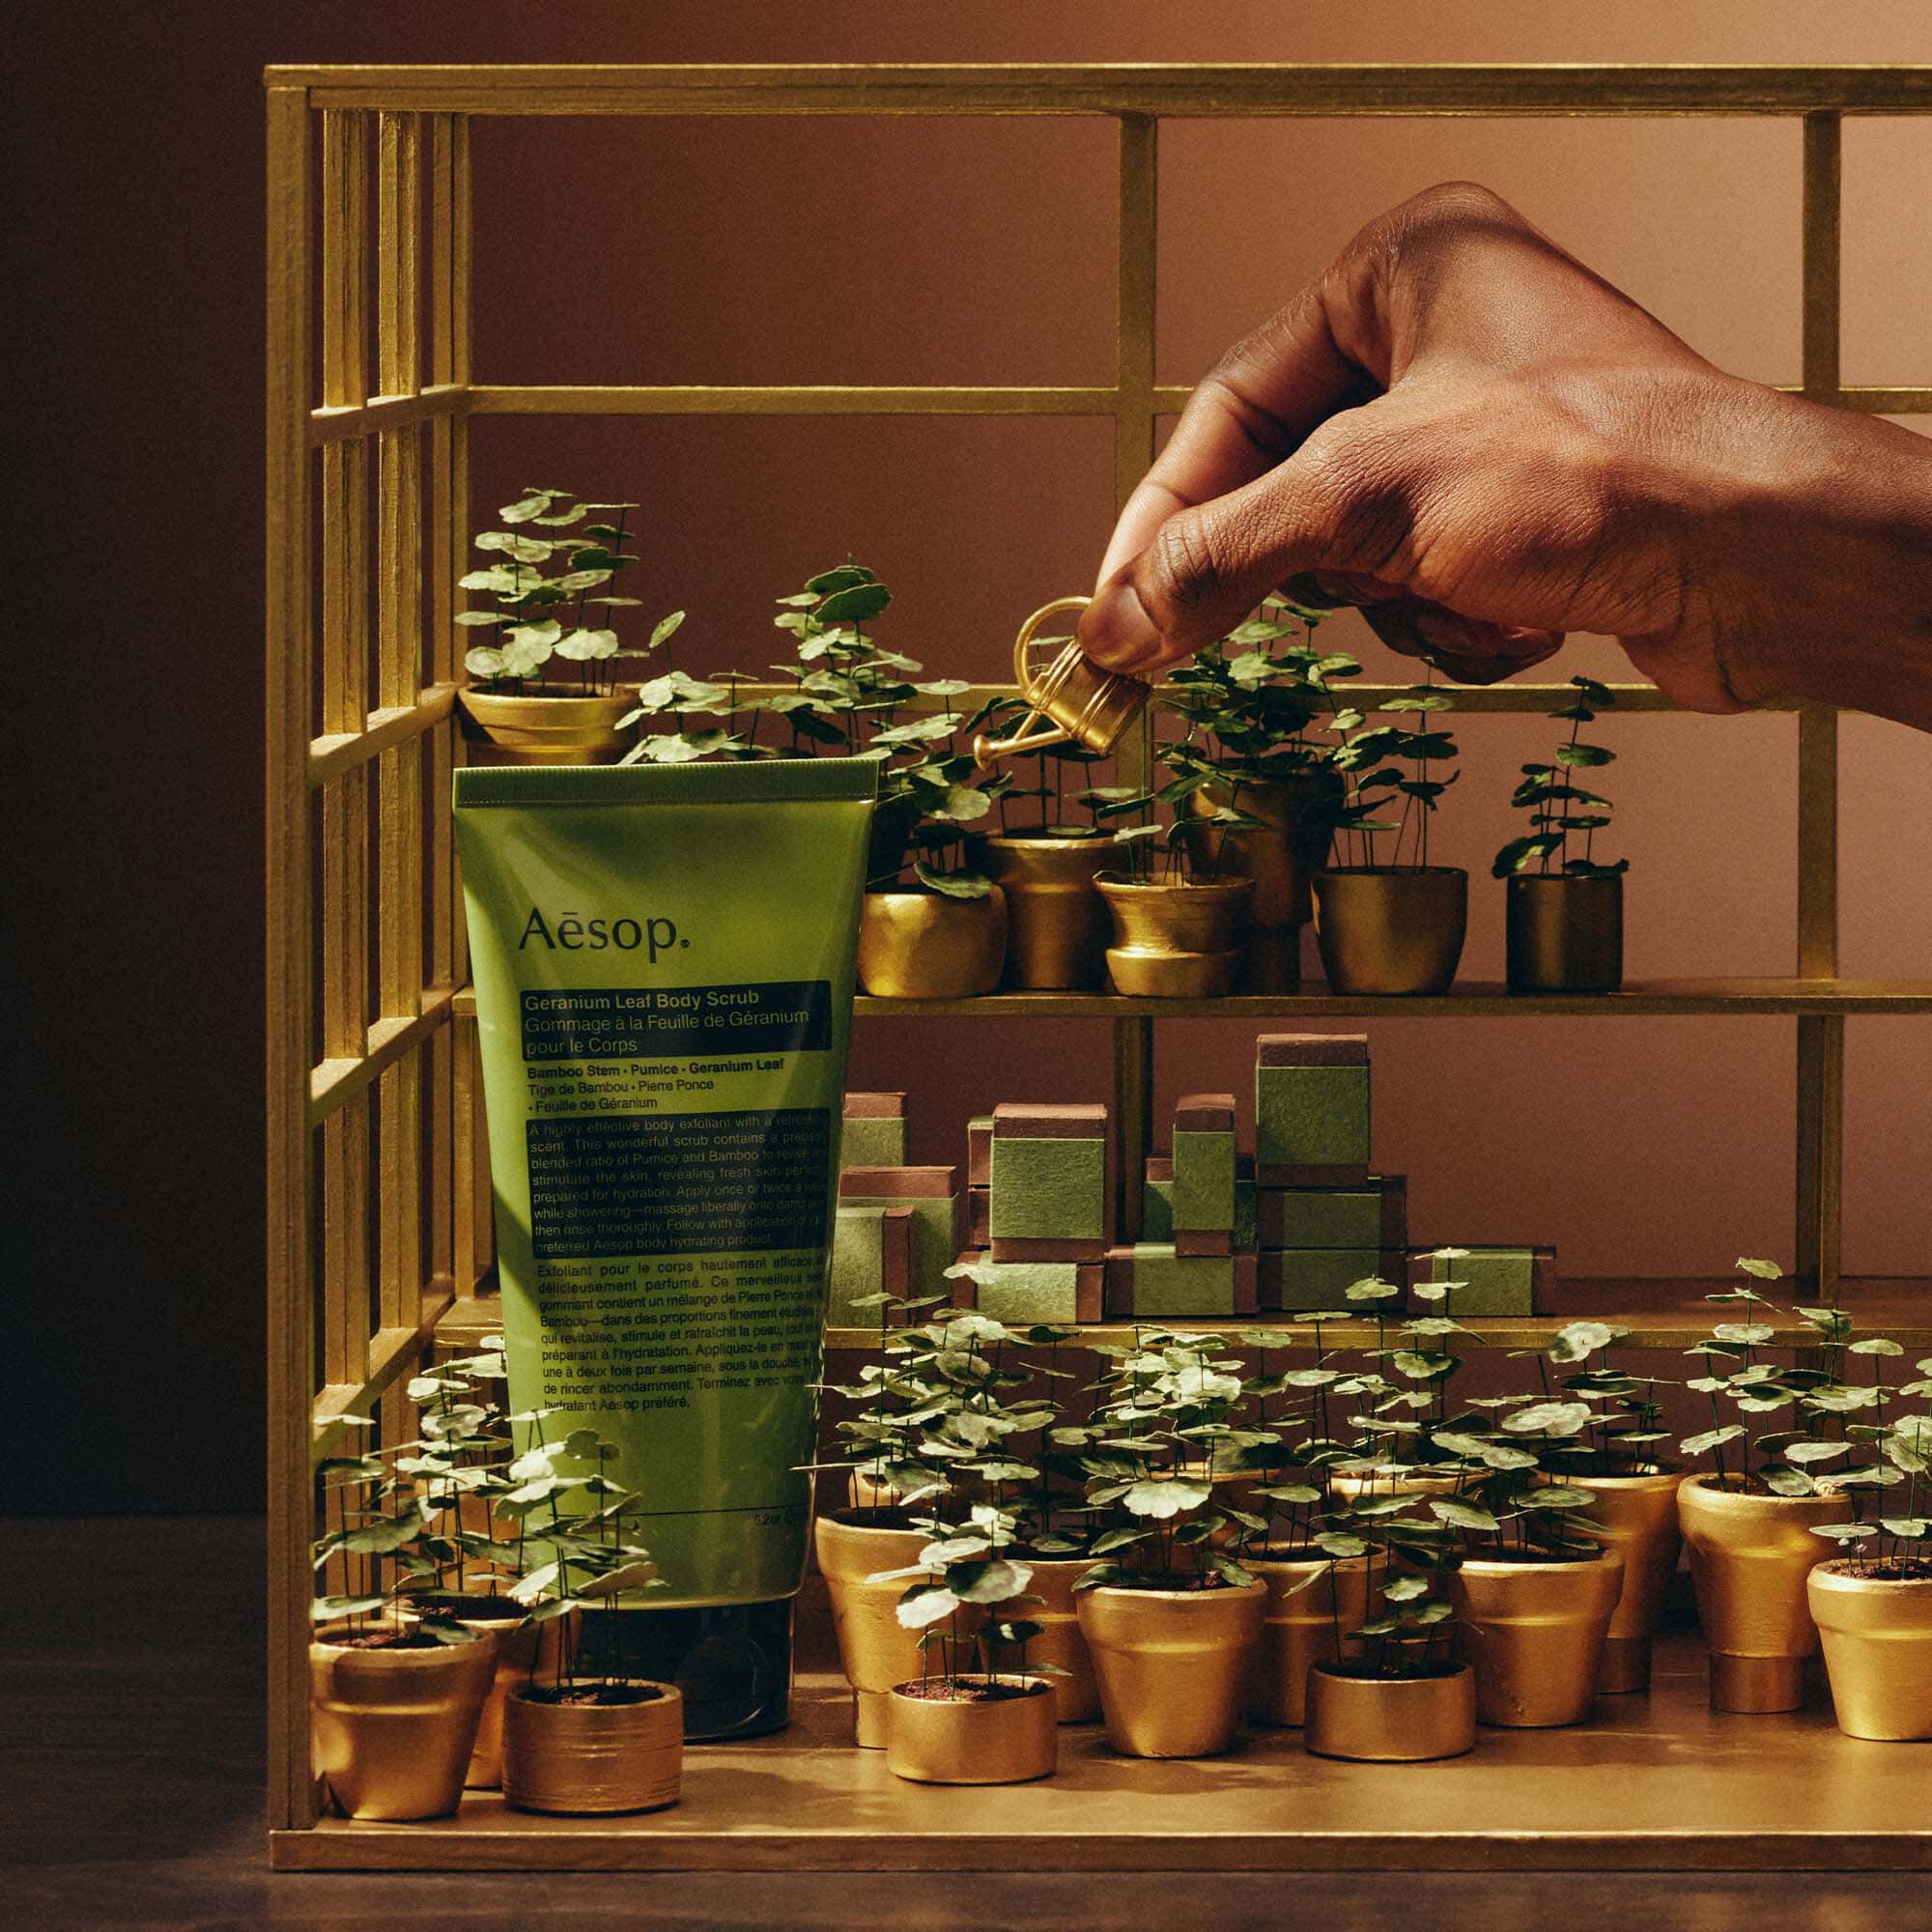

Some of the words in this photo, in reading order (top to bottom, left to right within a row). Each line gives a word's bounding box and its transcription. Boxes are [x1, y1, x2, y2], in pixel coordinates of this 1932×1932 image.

[526, 996, 611, 1011] Geranium
[614, 995, 652, 1009] Leaf
[657, 993, 700, 1010] Body
[706, 989, 759, 1007] Scrub
[526, 1017, 611, 1035] Gommage
[614, 1015, 625, 1030] à
[630, 1015, 642, 1030] la
[648, 1013, 698, 1030] Feuille
[704, 1012, 724, 1028] de
[729, 1009, 810, 1026] Géranium
[526, 1041, 565, 1058] pour
[569, 1037, 583, 1053] le
[588, 1037, 638, 1056] Corps
[527, 1066, 583, 1080] Bamboo
[587, 1065, 619, 1077] Stem
[631, 1063, 678, 1076] Pumice
[689, 1061, 753, 1074] Geranium
[756, 1058, 784, 1071] Leaf
[528, 1084, 554, 1096] Tige
[559, 1083, 575, 1094] de
[578, 1081, 628, 1094] Bambou
[639, 1080, 673, 1092] Pierre
[677, 1078, 714, 1091] Ponce
[535, 1099, 577, 1112] Feuille
[580, 1098, 595, 1111] de
[599, 1095, 657, 1110] Géranium
[530, 1125, 539, 1136] A
[587, 1122, 639, 1134] effective
[644, 1120, 674, 1132] body
[679, 1118, 728, 1130] exfoliant
[736, 1116, 759, 1127] with
[765, 1118, 772, 1126] a
[576, 1140, 601, 1151] This
[608, 1137, 668, 1150] wonderful
[675, 1135, 708, 1147] scrub
[713, 1132, 765, 1145] contains
[531, 1157, 582, 1170] blended
[585, 1156, 612, 1167] ratio
[617, 1155, 628, 1166] of
[633, 1153, 676, 1165] Pumice
[682, 1151, 705, 1162] and
[709, 1149, 759, 1161] Bamboo
[763, 1149, 772, 1158] to
[532, 1175, 589, 1186] stimulate
[597, 1173, 615, 1183] the
[658, 1168, 715, 1182] revealing
[721, 1167, 751, 1179] fresh
[756, 1165, 781, 1177] skin
[533, 1191, 588, 1205] prepared
[592, 1190, 609, 1200] for
[676, 1186, 710, 1199] Apply
[715, 1185, 744, 1195] once
[748, 1184, 757, 1194] or
[534, 1208, 565, 1219] while
[701, 1199, 747, 1214] liberally
[535, 1225, 560, 1236] then
[564, 1223, 592, 1235] rinse
[667, 1218, 704, 1231] Follow
[708, 1217, 731, 1229] with
[593, 1239, 633, 1253] Aesop
[637, 1237, 666, 1251] body
[669, 1235, 724, 1249] hydrating
[537, 1264, 592, 1277] Exfoliant
[600, 1264, 631, 1278] pour
[638, 1262, 649, 1274] le
[658, 1263, 694, 1275] corps
[701, 1259, 766, 1271] hautement
[773, 1256, 812, 1268] efficace
[538, 1280, 638, 1294] délicieusement
[645, 1277, 703, 1293] parfumé.
[711, 1275, 728, 1288] Ce
[736, 1273, 803, 1287] merveilleux
[539, 1298, 592, 1313] gommant
[596, 1296, 646, 1309] contient
[649, 1297, 665, 1308] un
[667, 1293, 718, 1308] mélange
[721, 1293, 735, 1304] de
[738, 1292, 771, 1303] Pierre
[773, 1290, 803, 1301] Ponce
[635, 1313, 657, 1325] des
[661, 1310, 726, 1325] proportions
[729, 1308, 777, 1321] finement
[541, 1333, 557, 1346] qui
[560, 1331, 617, 1345] revitalise,
[621, 1330, 666, 1342] stimule
[669, 1329, 681, 1340] et
[739, 1325, 750, 1337] la
[753, 1325, 782, 1338] peau,
[542, 1349, 597, 1364] préparant
[602, 1348, 610, 1359] à
[696, 1342, 767, 1356] Appliquez-le
[770, 1342, 782, 1351] en
[543, 1368, 562, 1378] une
[566, 1365, 573, 1377] à
[577, 1364, 608, 1377] deux
[611, 1363, 633, 1376] fois
[637, 1364, 657, 1377] par
[660, 1361, 715, 1375] semaine,
[719, 1360, 746, 1372] sous
[749, 1358, 759, 1370] la
[544, 1382, 557, 1394] de
[560, 1382, 593, 1394] rincer
[599, 1379, 694, 1393] abondamment.
[696, 1376, 750, 1390] Terminez
[755, 1376, 780, 1386] avec
[600, 1398, 639, 1411] Aesop
[642, 1395, 690, 1409] préféré.
